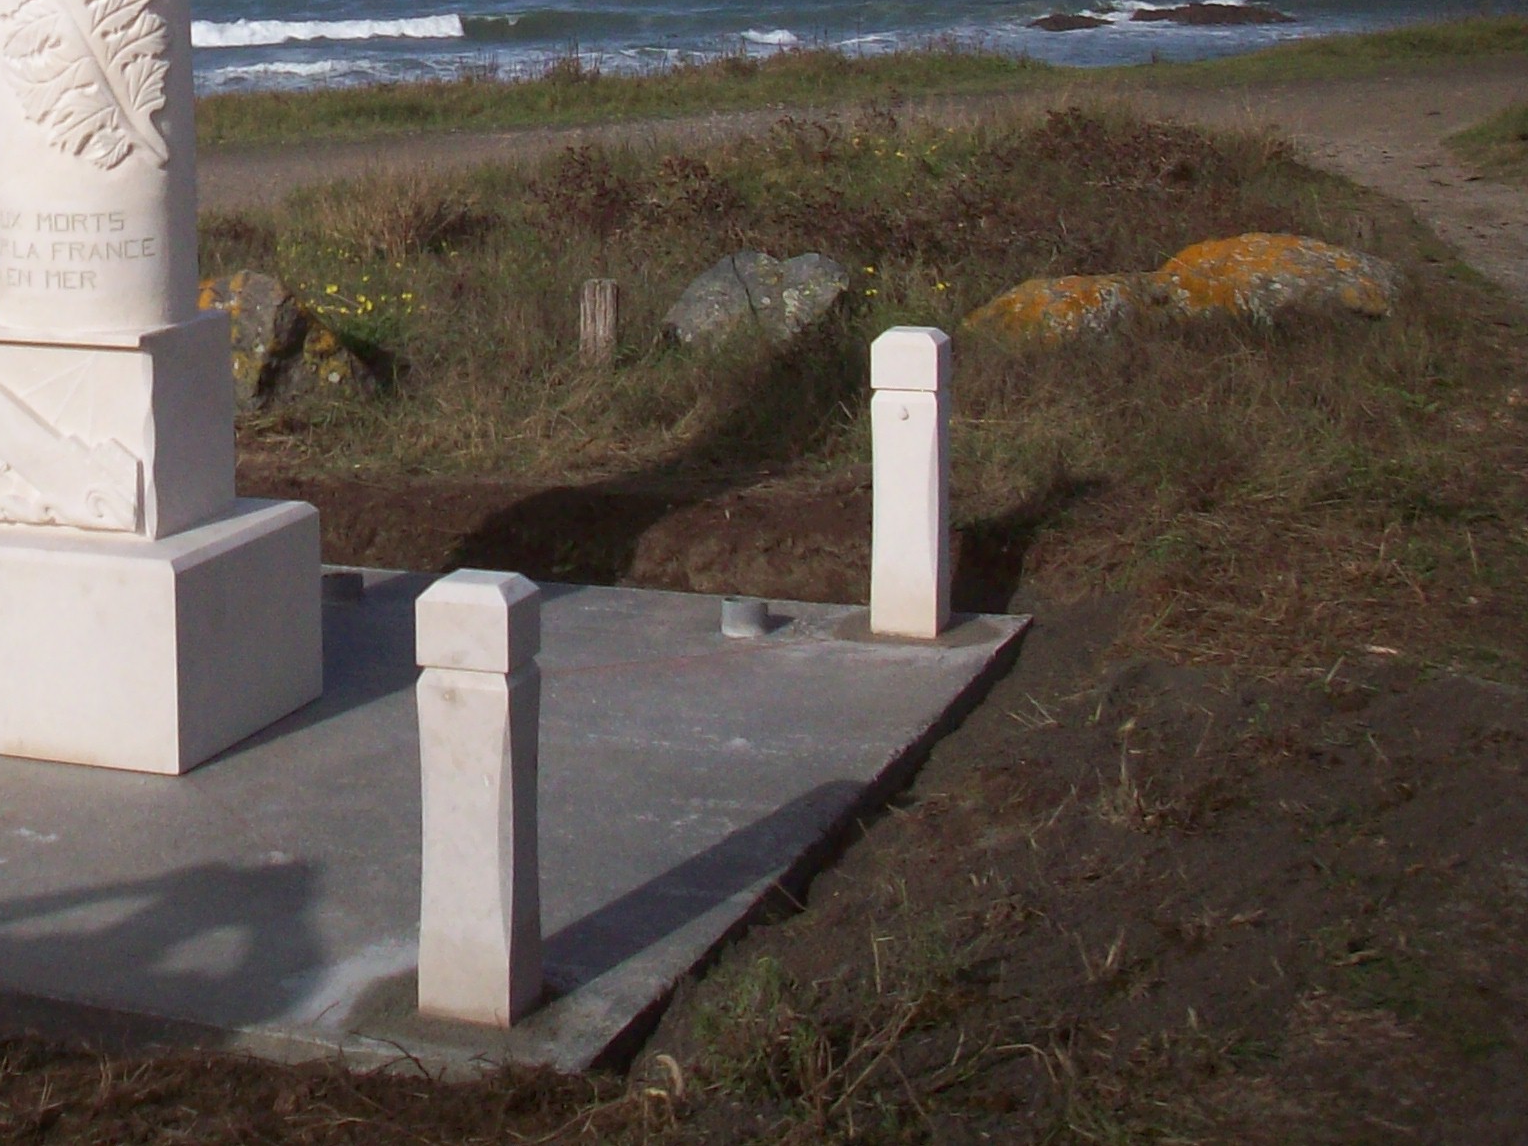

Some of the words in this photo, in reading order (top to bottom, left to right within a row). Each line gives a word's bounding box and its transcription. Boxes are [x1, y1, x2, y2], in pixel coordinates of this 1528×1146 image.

[37, 211, 125, 233] MORTS
[12, 241, 40, 260] LA
[51, 237, 157, 262] FRANCE
[6, 267, 32, 288] EN
[45, 269, 98, 290] MER
